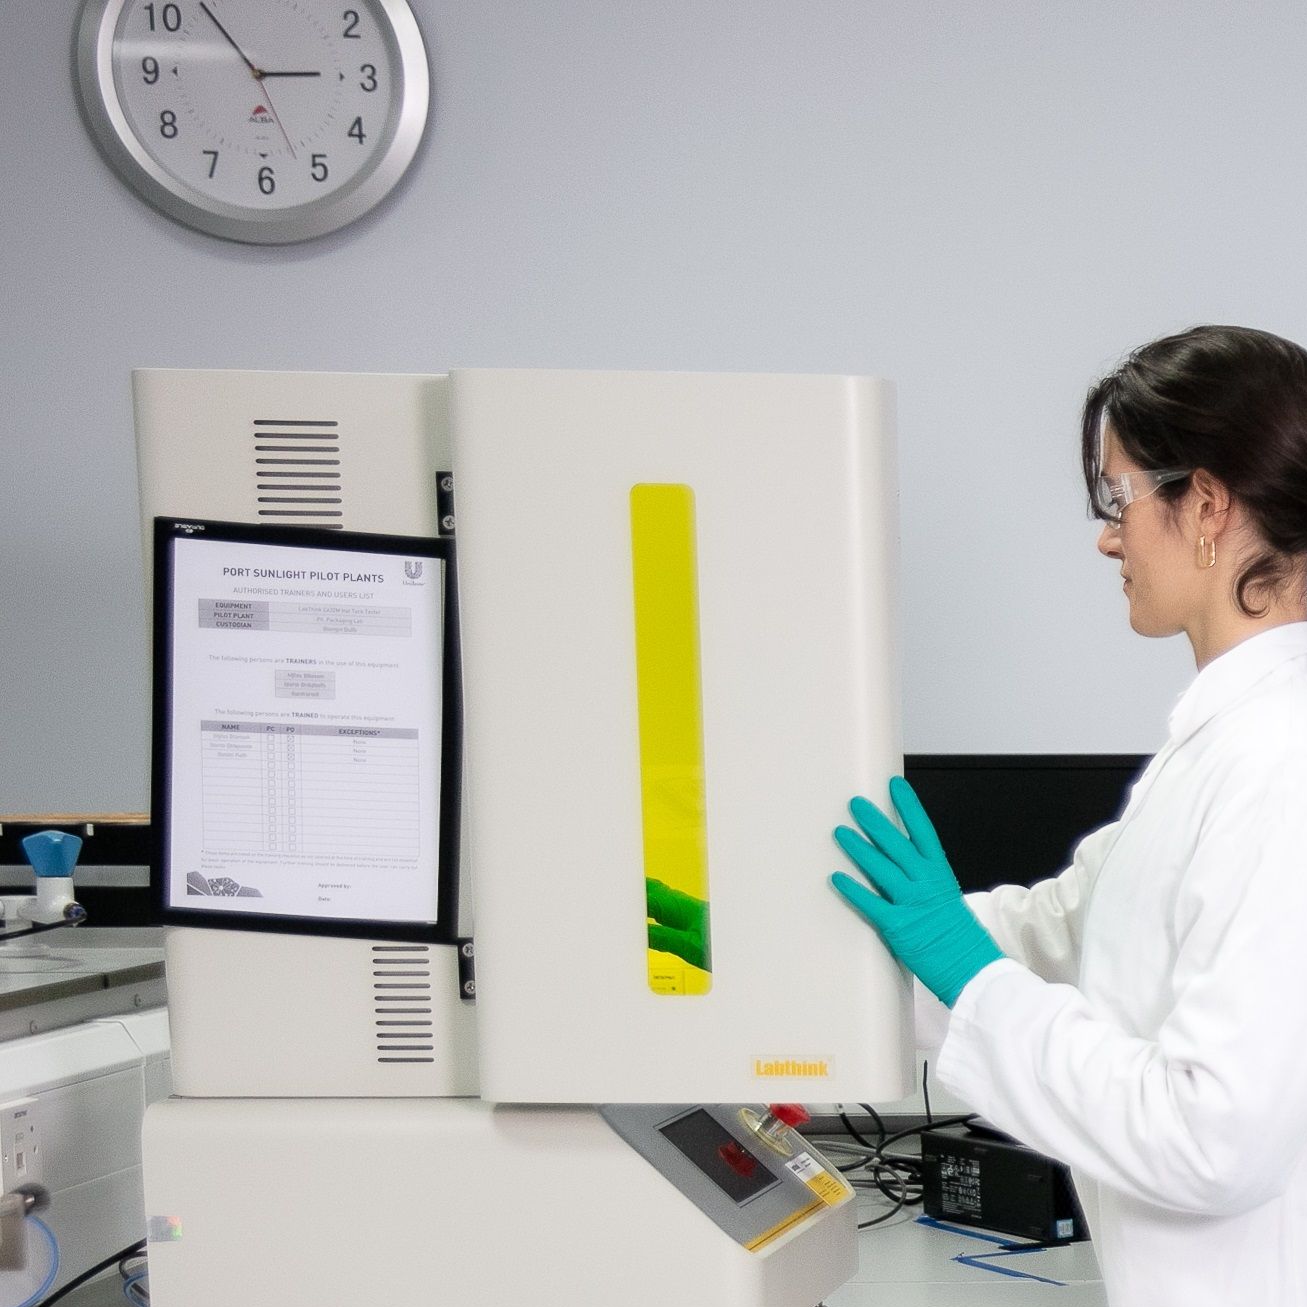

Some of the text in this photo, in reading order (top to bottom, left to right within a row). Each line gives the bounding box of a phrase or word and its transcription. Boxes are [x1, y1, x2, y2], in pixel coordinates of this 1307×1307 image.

[144, 3, 182, 32] 10
[342, 10, 361, 39] 2
[142, 56, 160, 85] 9
[359, 64, 378, 92] 3
[160, 110, 178, 139] 8
[347, 116, 366, 145] 4
[202, 150, 219, 178] 7
[311, 154, 329, 182] 5
[258, 166, 276, 195] 6
[223, 567, 385, 583] PORT SUNLIGHT PILOT PLANTS
[233, 587, 374, 600] AUTHORISED TRAINERS AND USERS LIST
[755, 1059, 829, 1076] Labthink
